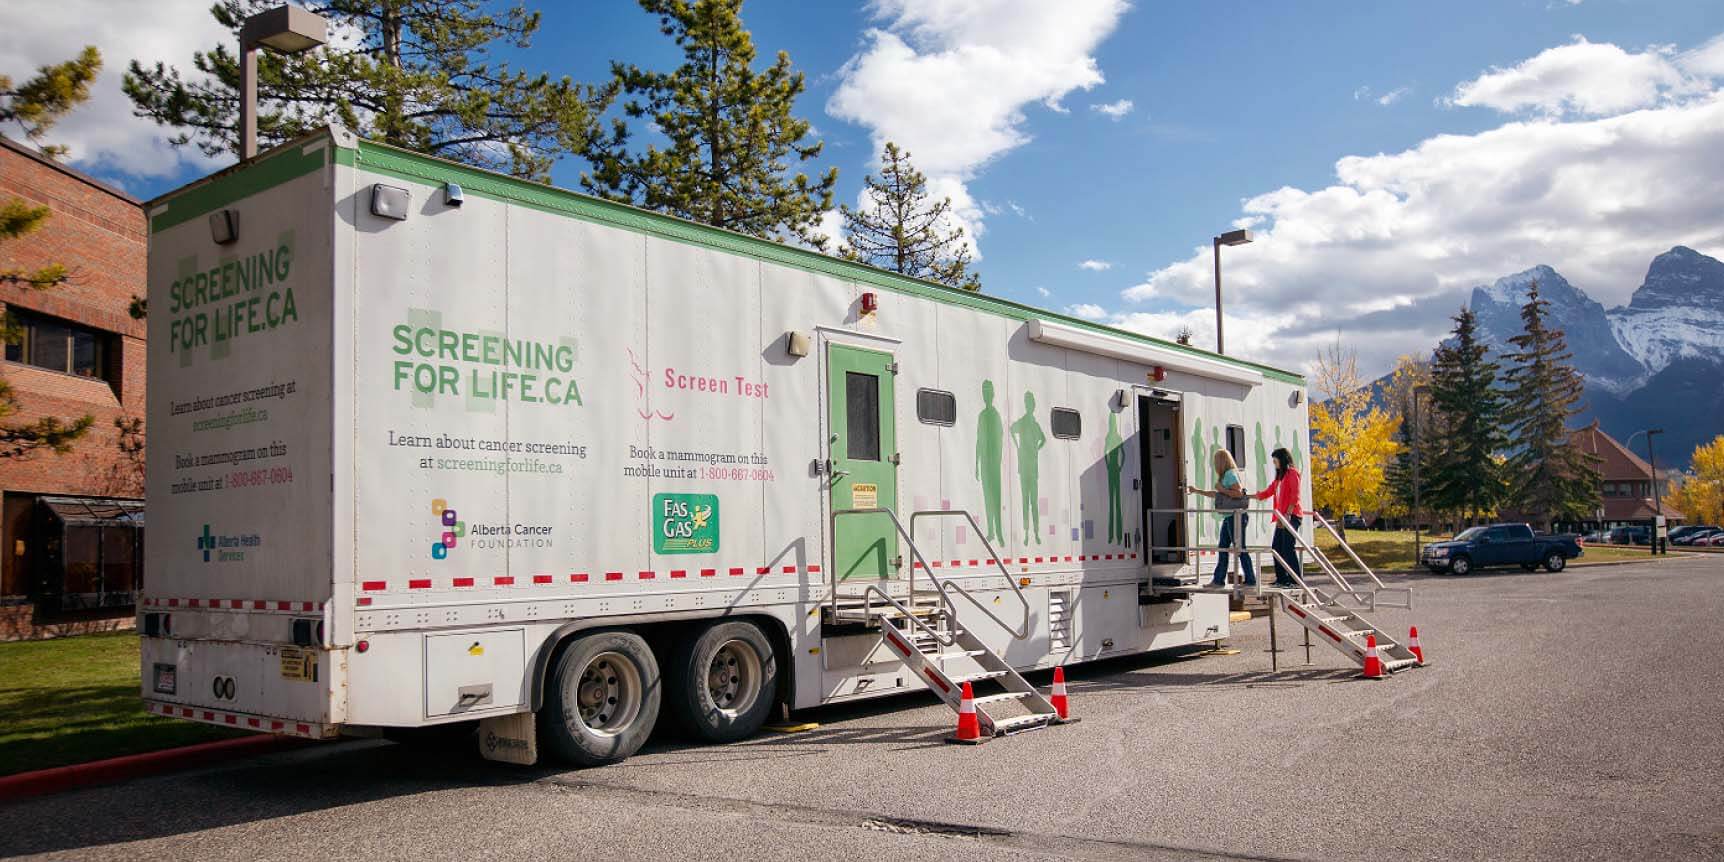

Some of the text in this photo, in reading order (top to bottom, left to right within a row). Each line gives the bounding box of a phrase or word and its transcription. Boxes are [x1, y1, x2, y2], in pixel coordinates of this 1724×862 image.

[170, 245, 290, 313] SCREENING
[170, 287, 298, 352] FOR LIFE.CA
[392, 324, 574, 373] SCREENING
[394, 360, 583, 407] FOR LIFE.CA
[664, 367, 769, 399] Screen Test
[170, 379, 296, 416] Learn about cancer screening at
[193, 407, 268, 432] screeningforlife.ca
[175, 440, 287, 469] Book a mammogram on this
[388, 430, 587, 459] Learn about cancer screening
[629, 445, 768, 465] Book a mammogram on this
[419, 456, 563, 475] at screeningforlife.ca
[624, 464, 775, 482] mobile unit at 1-800-667-0604
[171, 478, 196, 494] mobile
[198, 479, 214, 491] unit
[215, 477, 223, 490] at
[663, 498, 688, 517] FAS
[471, 524, 553, 536] Alberta Cancer
[663, 518, 692, 538] GAS
[219, 534, 261, 547] Alberta Health
[471, 538, 553, 549] FOUNDATION
[687, 538, 712, 549] PLUS
